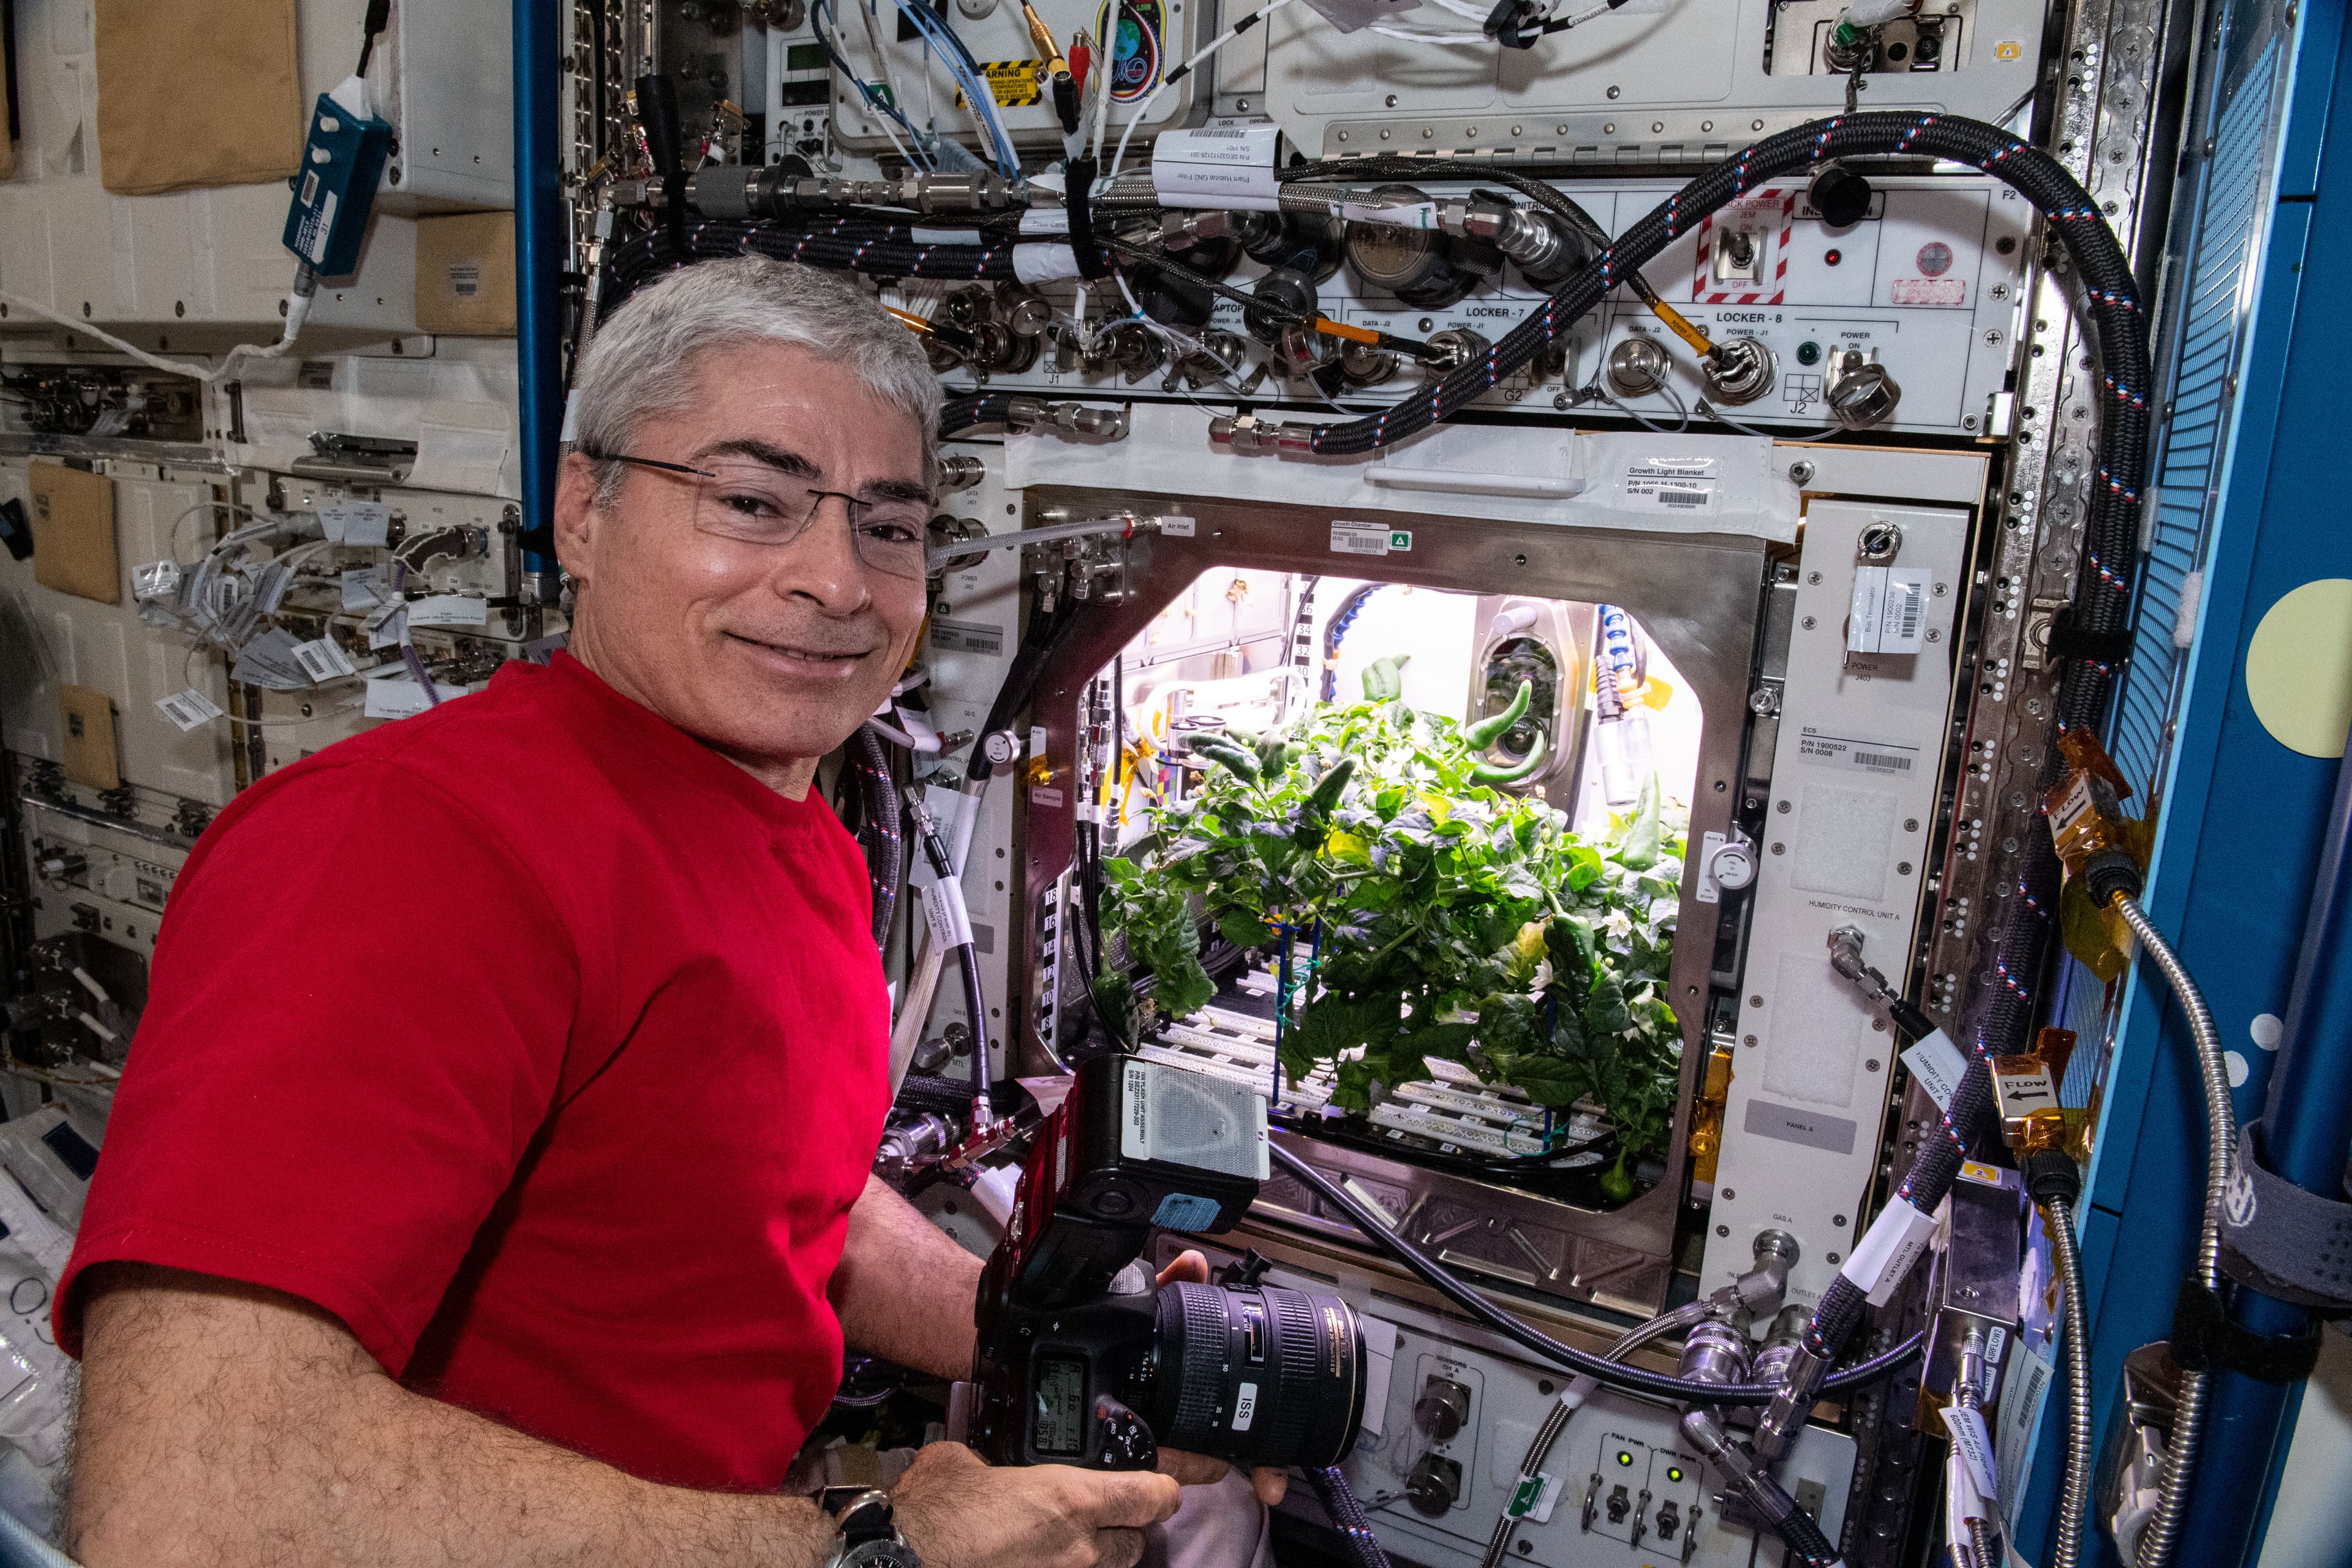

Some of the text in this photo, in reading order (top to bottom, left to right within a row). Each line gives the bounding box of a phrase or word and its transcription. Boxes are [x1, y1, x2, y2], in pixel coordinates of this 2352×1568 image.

[986, 69, 1020, 78] ARNING
[2002, 190, 2016, 199] F2
[321, 224, 328, 235] 31
[1213, 304, 1244, 313] APTOP
[1466, 308, 1509, 317] LOCKER
[1716, 313, 1782, 323] LOCKER 8
[1049, 374, 1060, 384] J1
[1504, 390, 1522, 401] G2
[1790, 402, 1807, 414] J2
[1657, 469, 1675, 477] Light
[1866, 586, 1875, 619] Terminator
[1887, 591, 1895, 618] 1900236
[1298, 624, 1311, 635] 34
[1297, 645, 1310, 656] 32
[1852, 662, 1878, 671] POWER
[1817, 742, 1847, 751] 1900522
[2052, 786, 2084, 820] FLOW
[1047, 890, 1057, 902] 18
[1809, 900, 1842, 911] HUMIDITY
[1843, 905, 1875, 917] CONTROL
[930, 888, 947, 944] HUMIDITY CONTROL
[1046, 916, 1056, 928] 16
[1046, 941, 1055, 954] 14
[1044, 967, 1054, 979] 12
[1044, 992, 1054, 1004] 10
[1045, 1017, 1050, 1029] 8
[952, 1058, 964, 1068] MTL
[1917, 1052, 1943, 1083] HUMIDITY
[1924, 1078, 1940, 1094] UNIT
[2004, 1080, 2047, 1090] FLOW
[1786, 1122, 1807, 1131] PANEL
[1902, 1241, 1913, 1253] MTL
[1888, 1254, 1905, 1278] OUTLET
[1791, 1287, 1816, 1299] OUTLET
[1987, 1329, 2002, 1361] AIRFLOW2
[1436, 1355, 1467, 1369] SENSORS
[1238, 1398, 1253, 1419] ISS
[1128, 1425, 1137, 1436] OFF
[1125, 1436, 1131, 1446] ON
[1611, 1433, 1645, 1447] FAN PWR
[1950, 1414, 1978, 1461] 600mm (M732)
[1958, 1407, 1989, 1471] JEM WIS Air Flow
[1660, 1447, 1697, 1463] DWR PWR
